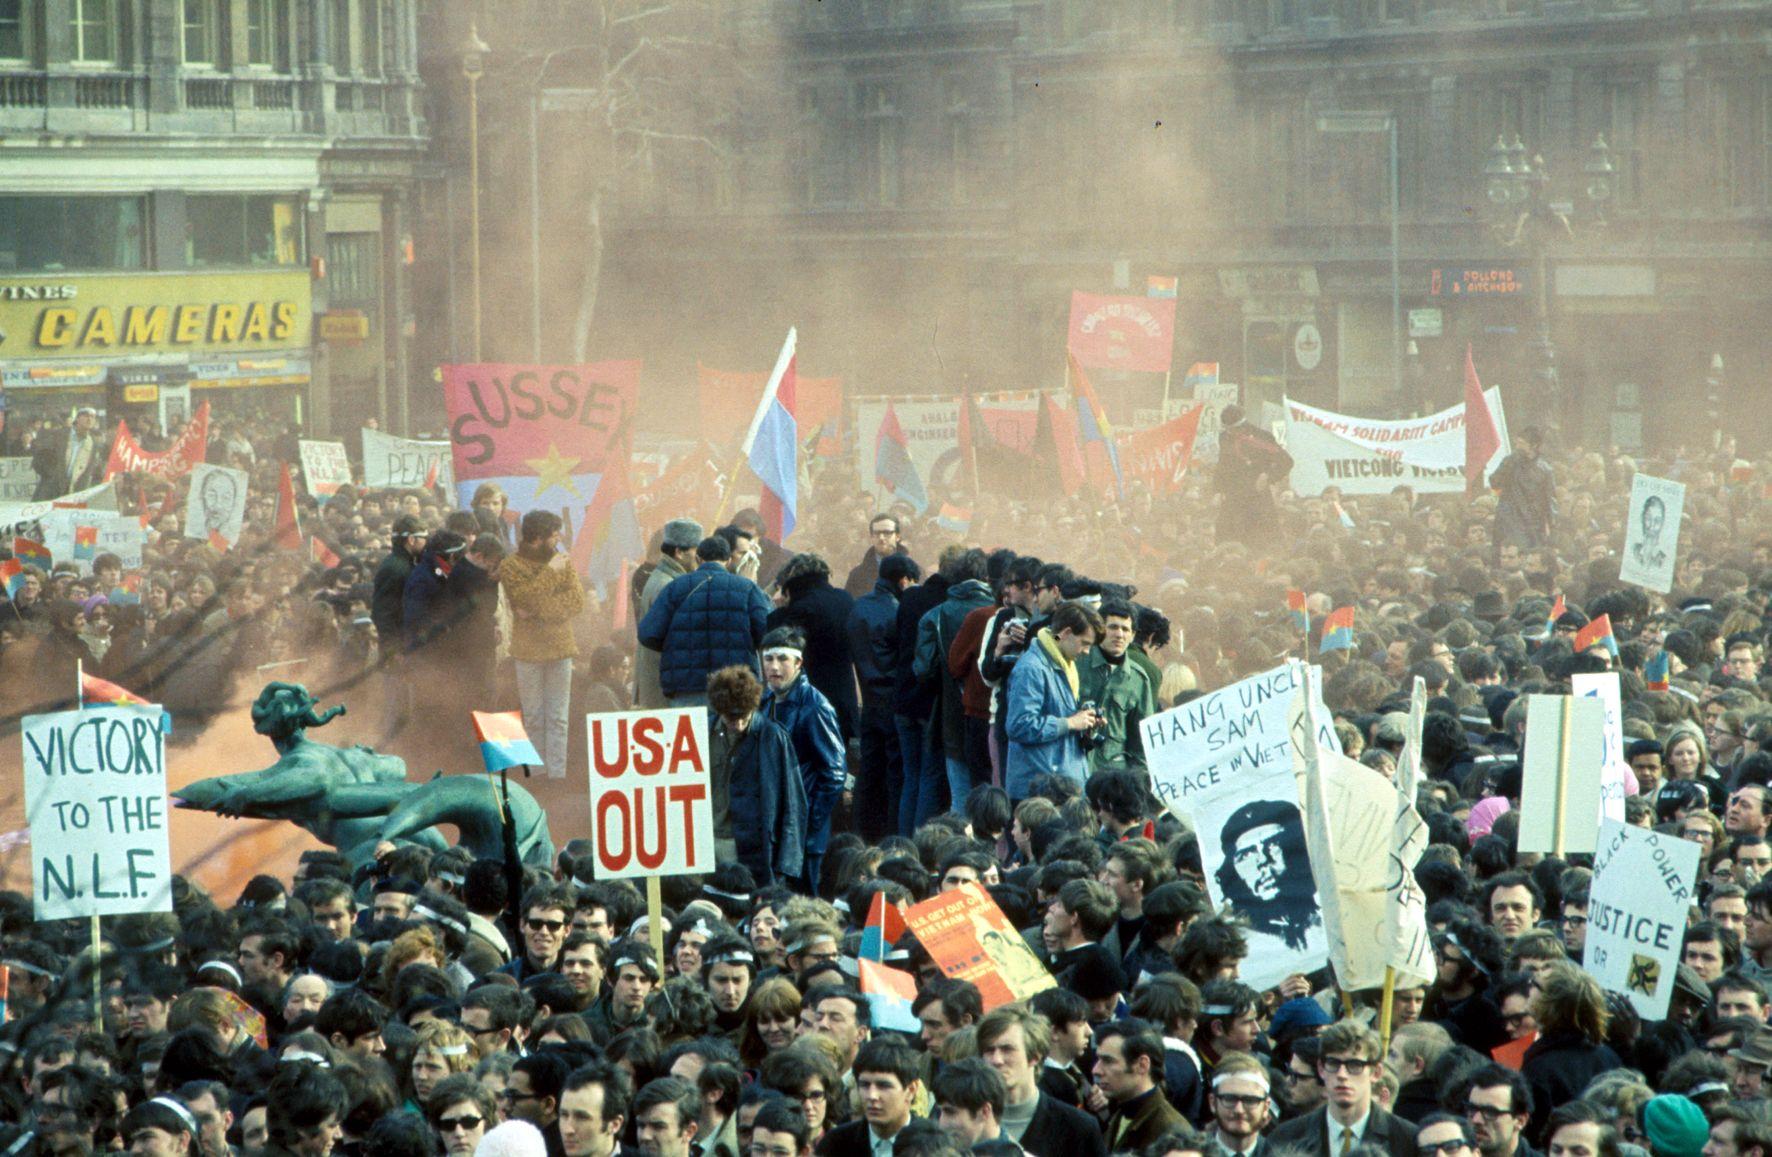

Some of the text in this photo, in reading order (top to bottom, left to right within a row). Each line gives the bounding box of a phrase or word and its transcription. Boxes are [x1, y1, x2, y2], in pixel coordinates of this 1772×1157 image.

[36, 302, 298, 349] CAMERAS
[451, 369, 630, 466] SUSSEX
[1289, 406, 1347, 438] VINAM
[1430, 412, 1466, 436] CAMP
[1325, 458, 1405, 479] VIETCONG
[25, 716, 163, 776] VICTORY
[1147, 693, 1226, 751] HANG
[1207, 711, 1264, 752] SAM
[1151, 740, 1289, 803] PEACE IN VIET
[51, 796, 162, 834] TO THE
[596, 783, 707, 872] OUT
[1593, 827, 1630, 879] BLACK
[1644, 834, 1689, 904] POWER
[916, 913, 966, 938] VIETNAM
[927, 908, 946, 921] GET
[946, 900, 966, 913] OUT
[1587, 898, 1674, 951] JUSTICE
[1594, 946, 1608, 969] OR
